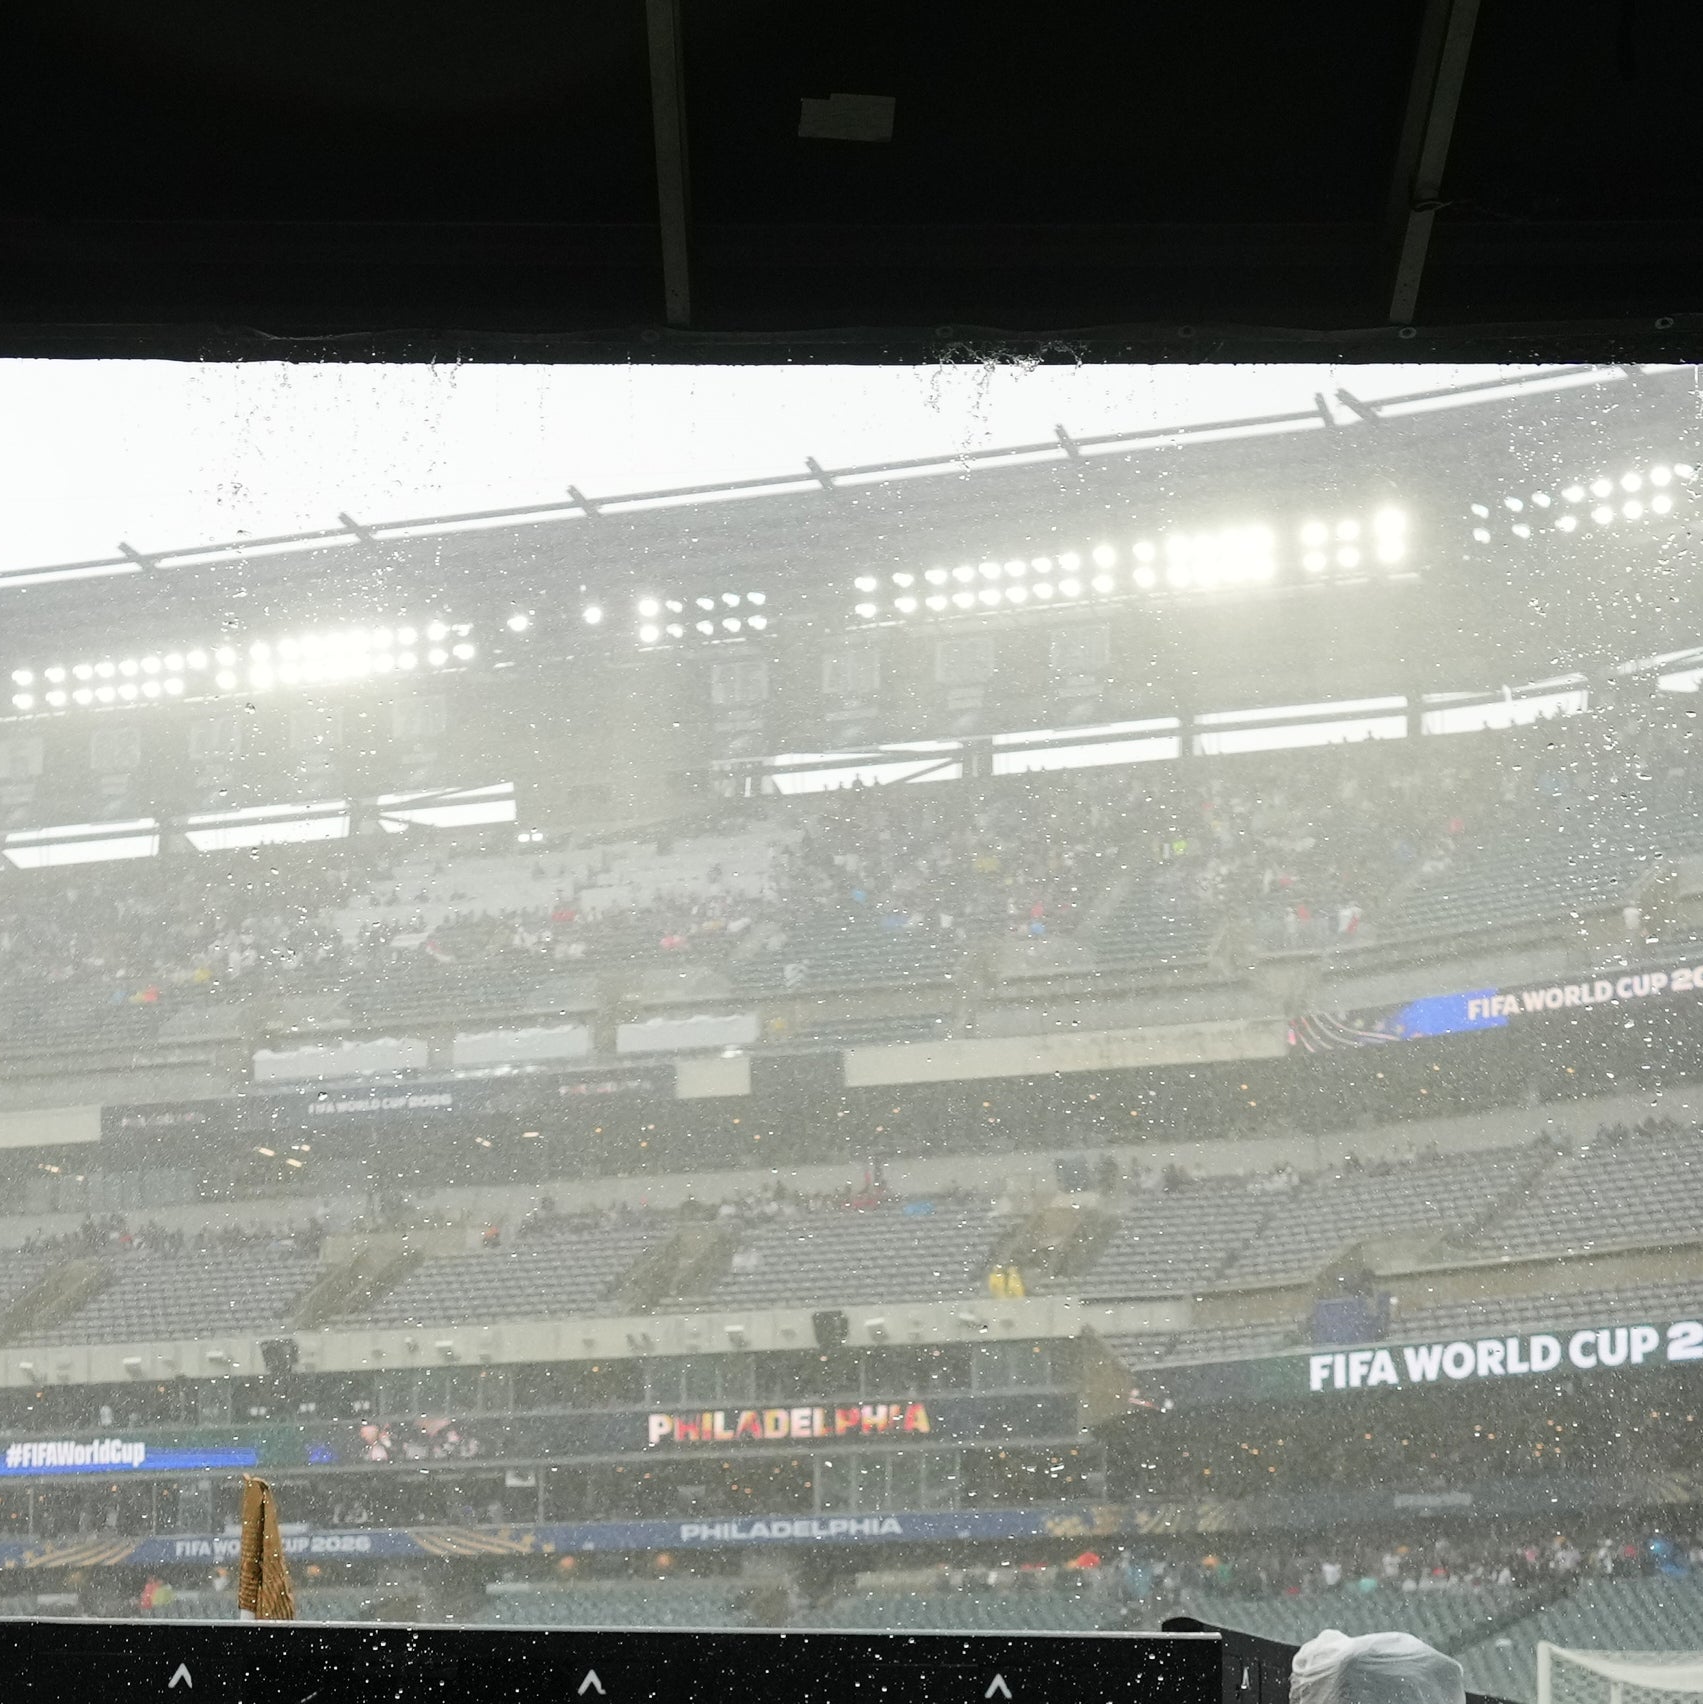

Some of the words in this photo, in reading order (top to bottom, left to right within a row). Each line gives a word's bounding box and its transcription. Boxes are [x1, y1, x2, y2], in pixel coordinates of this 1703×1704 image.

[1467, 994, 1520, 1021] FIFA
[1523, 984, 1611, 1013] WORLD
[1617, 972, 1670, 1000] CUP
[1308, 1352, 1399, 1393] FIFA
[1402, 1336, 1562, 1384] WORLD
[1568, 1325, 1660, 1370] CUP
[648, 1402, 931, 1444] PHILADELPHIA
[6, 1438, 146, 1468] #FIFAWorldCup
[175, 1540, 211, 1557] FIFA
[311, 1535, 372, 1553] 2026
[680, 1517, 904, 1541] PHILADELPHIA
